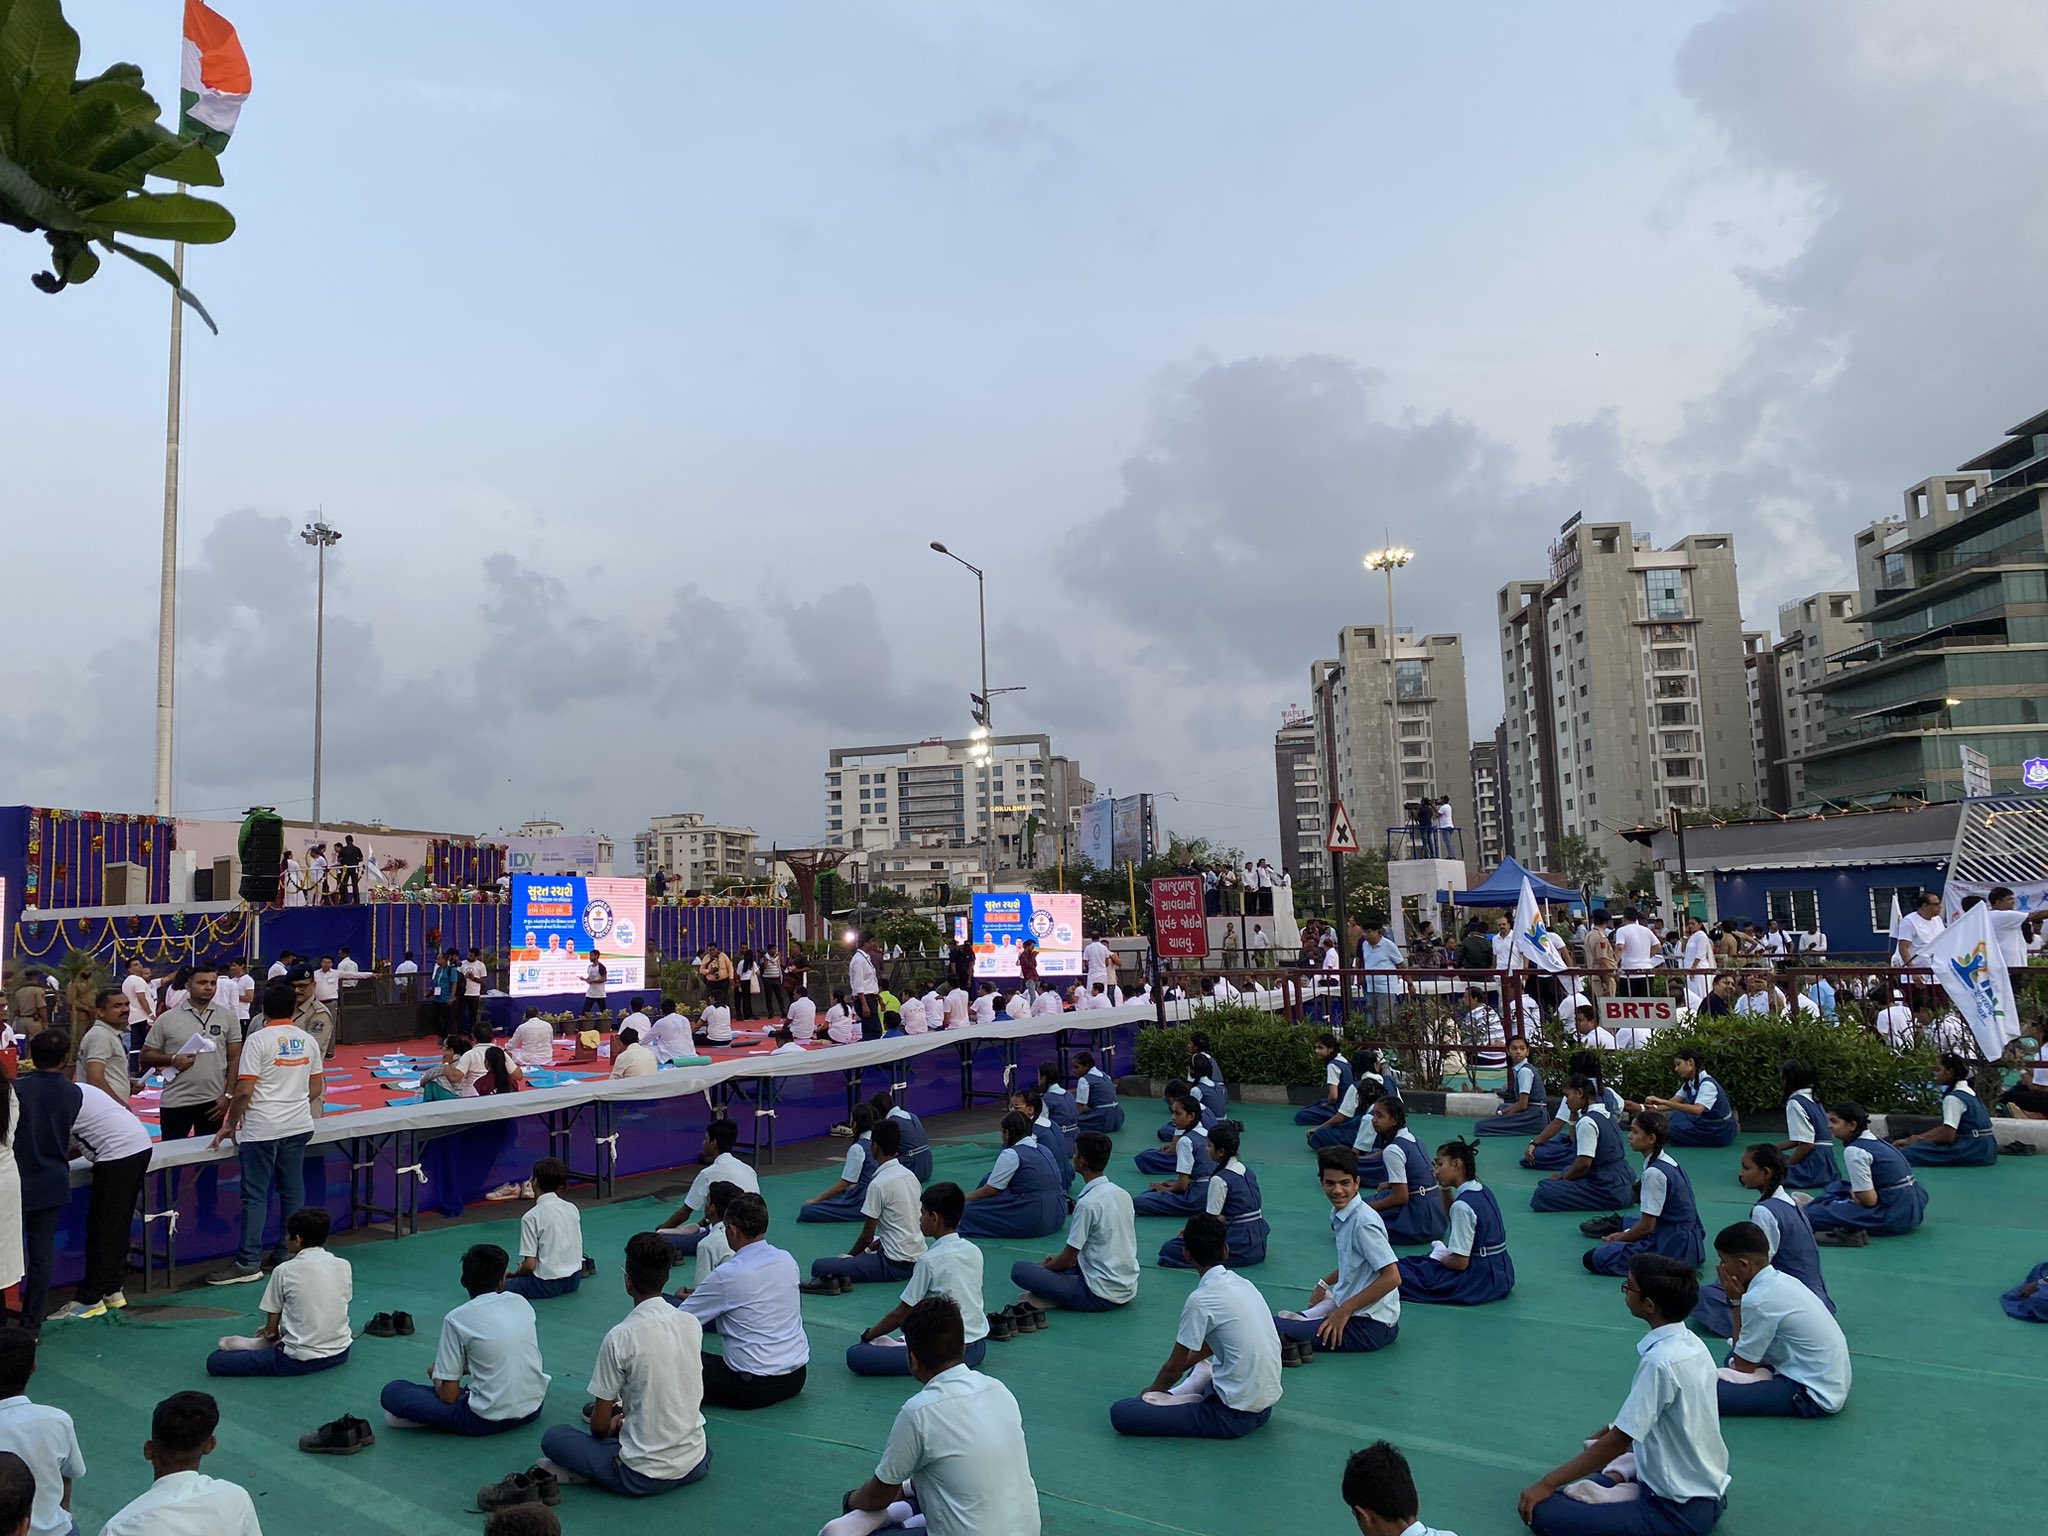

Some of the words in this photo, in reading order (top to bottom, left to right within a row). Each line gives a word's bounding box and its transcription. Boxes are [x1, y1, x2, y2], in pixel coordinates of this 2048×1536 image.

[509, 853, 536, 867] IDY
[527, 885, 549, 901] સુરત
[550, 882, 573, 897] રચશે
[1158, 880, 1197, 897] આજુબાજુ
[586, 900, 610, 912] GUINNESS
[1161, 896, 1196, 911] સાવધાની
[1158, 915, 1177, 934] પૂર્વક
[528, 968, 541, 977] IDY
[1606, 1002, 1671, 1019] BRTS
[289, 1039, 305, 1048] IDY
